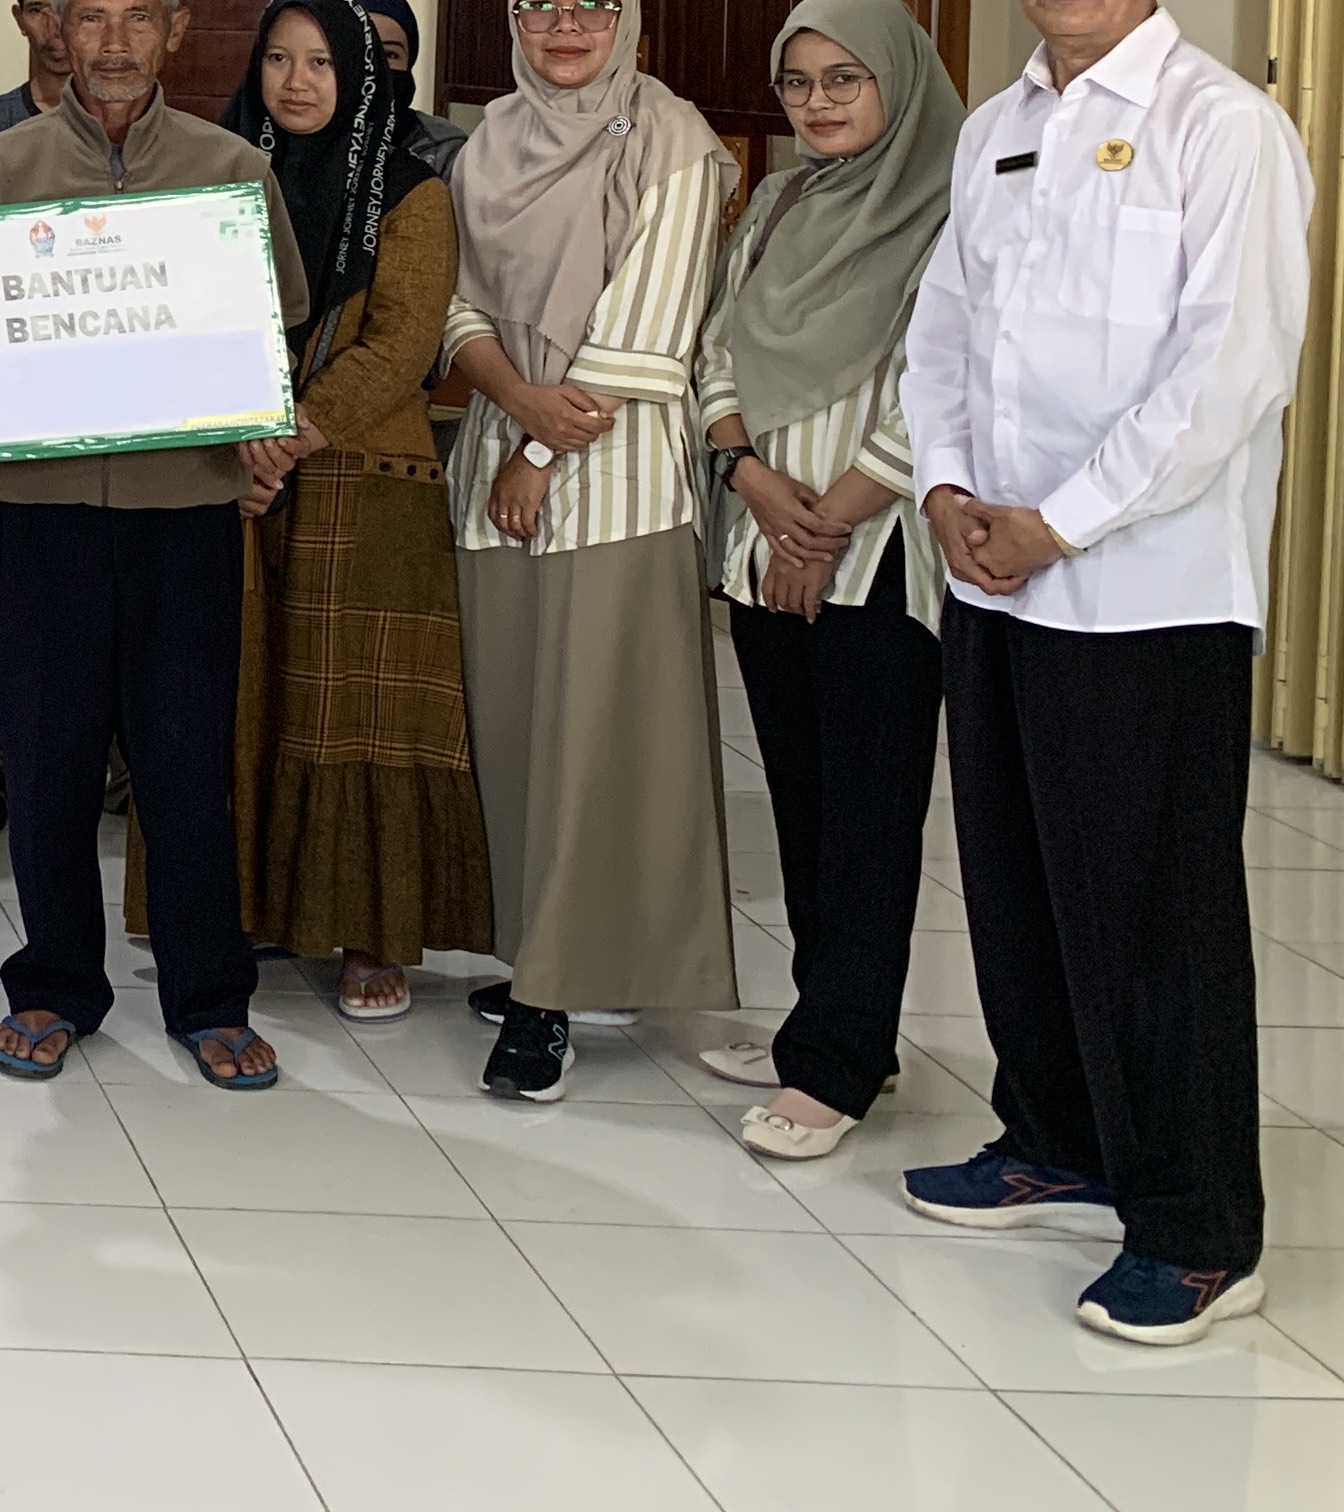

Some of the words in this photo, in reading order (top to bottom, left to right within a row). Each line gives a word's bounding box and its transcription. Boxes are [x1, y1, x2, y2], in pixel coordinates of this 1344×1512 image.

[76, 234, 122, 247] BAZNAS
[1, 261, 168, 302] BANTUAN
[5, 303, 177, 345] BENCANA
